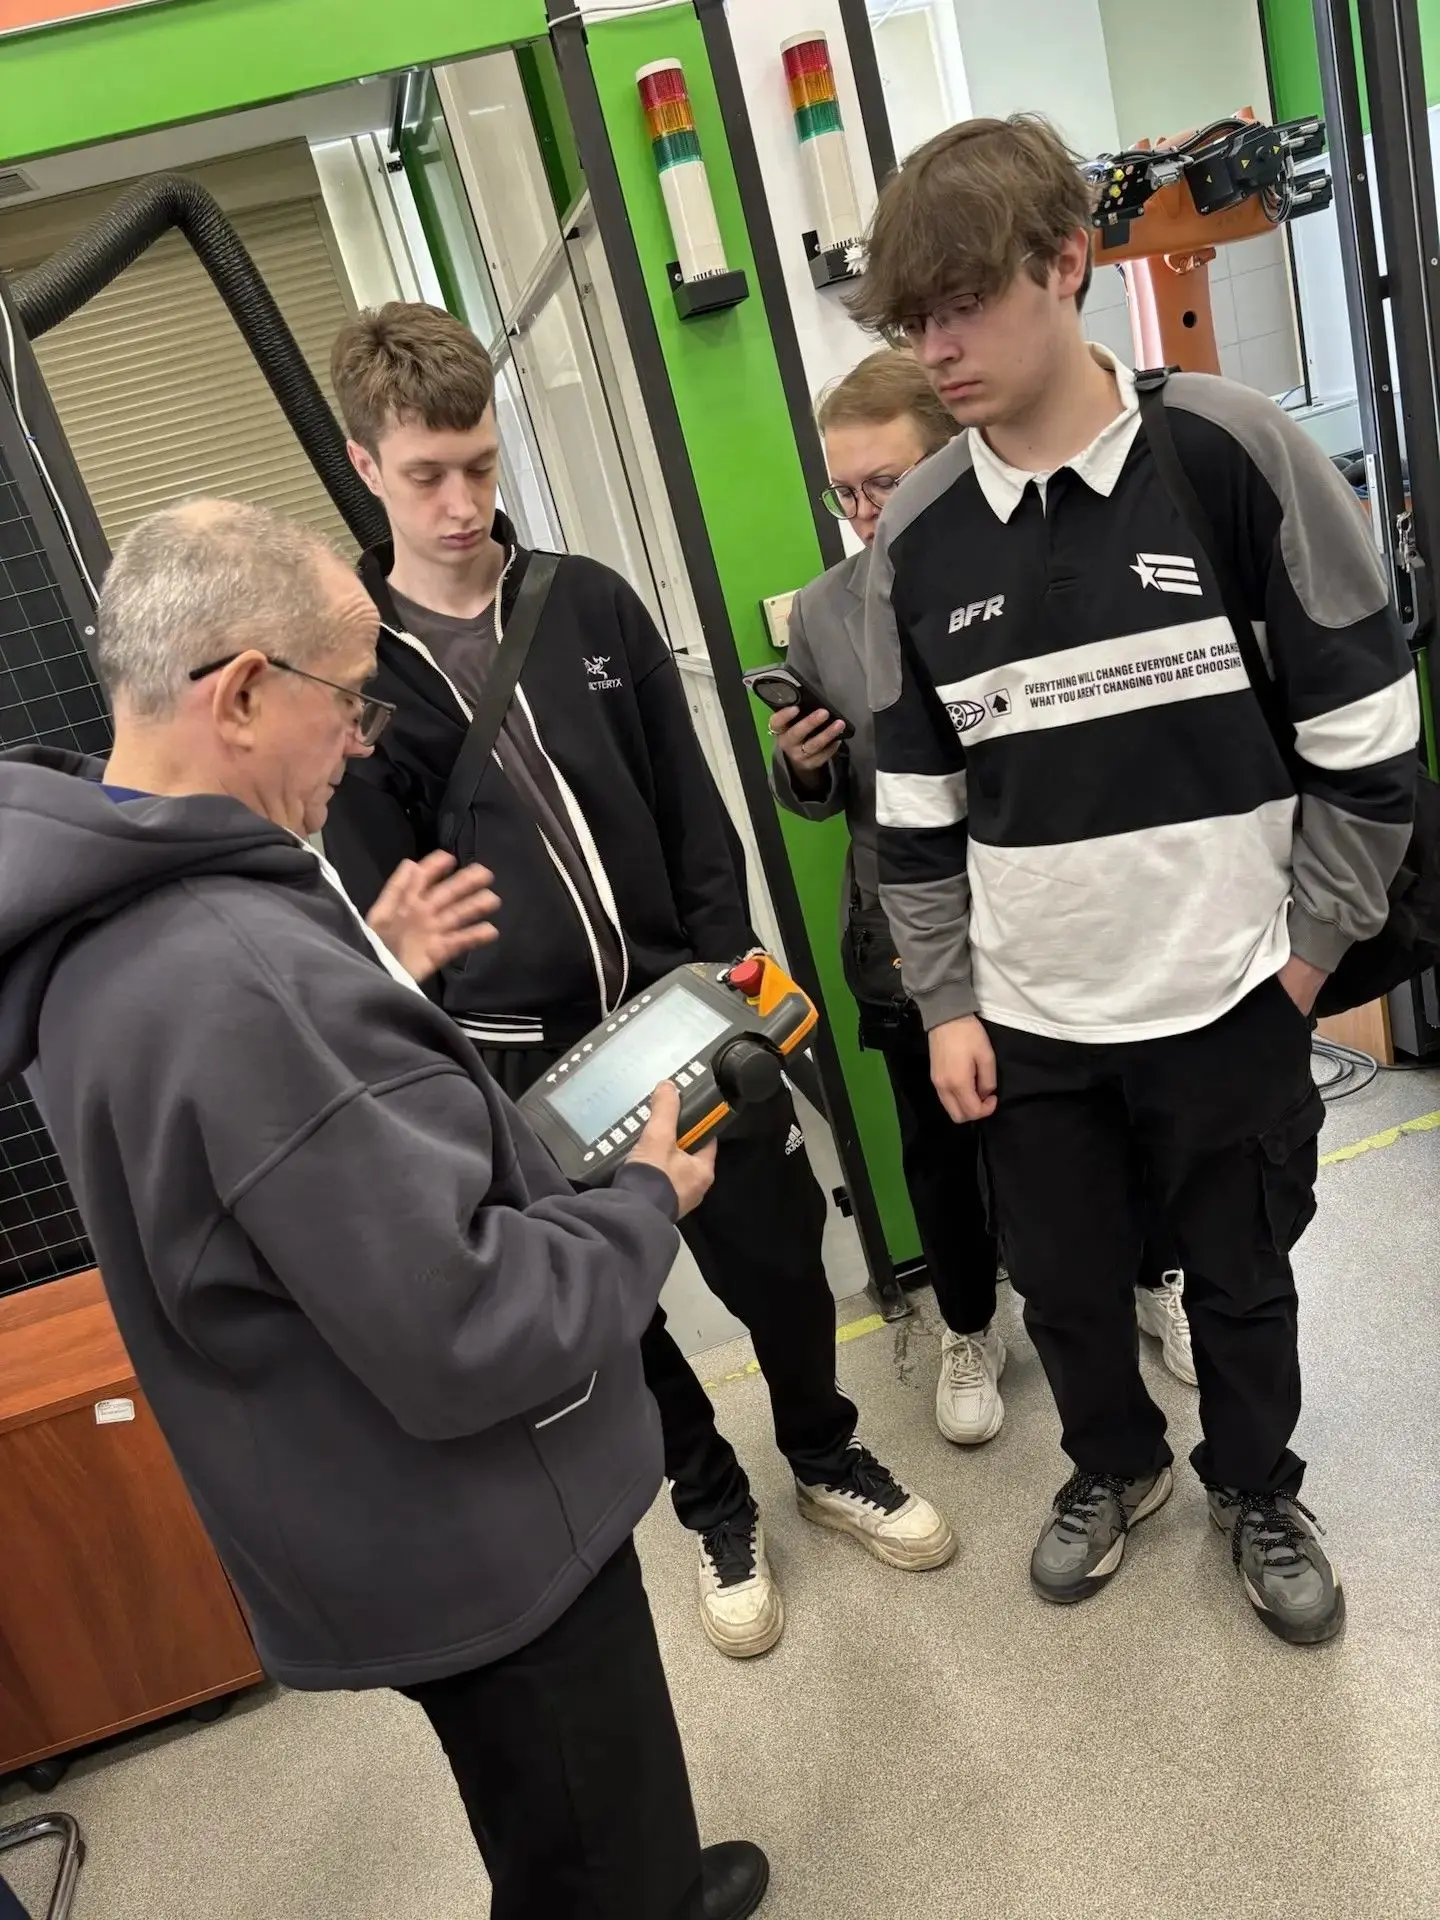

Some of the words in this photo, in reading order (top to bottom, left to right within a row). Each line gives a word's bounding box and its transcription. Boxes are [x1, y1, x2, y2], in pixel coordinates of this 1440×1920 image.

[948, 594, 1005, 634] BFR
[1024, 675, 1077, 695] EVERYTHING
[1077, 671, 1095, 684] WILL
[1096, 663, 1134, 680] CHANGE
[1136, 653, 1185, 673] EVERYONE
[1186, 648, 1206, 662] CAN
[1029, 695, 1056, 708] WHAT
[1057, 691, 1076, 704] YOU
[1077, 683, 1100, 699] AREN'T
[1103, 674, 1153, 694] CHANGING
[1154, 670, 1174, 684] YOU
[1175, 666, 1195, 680] ARE
